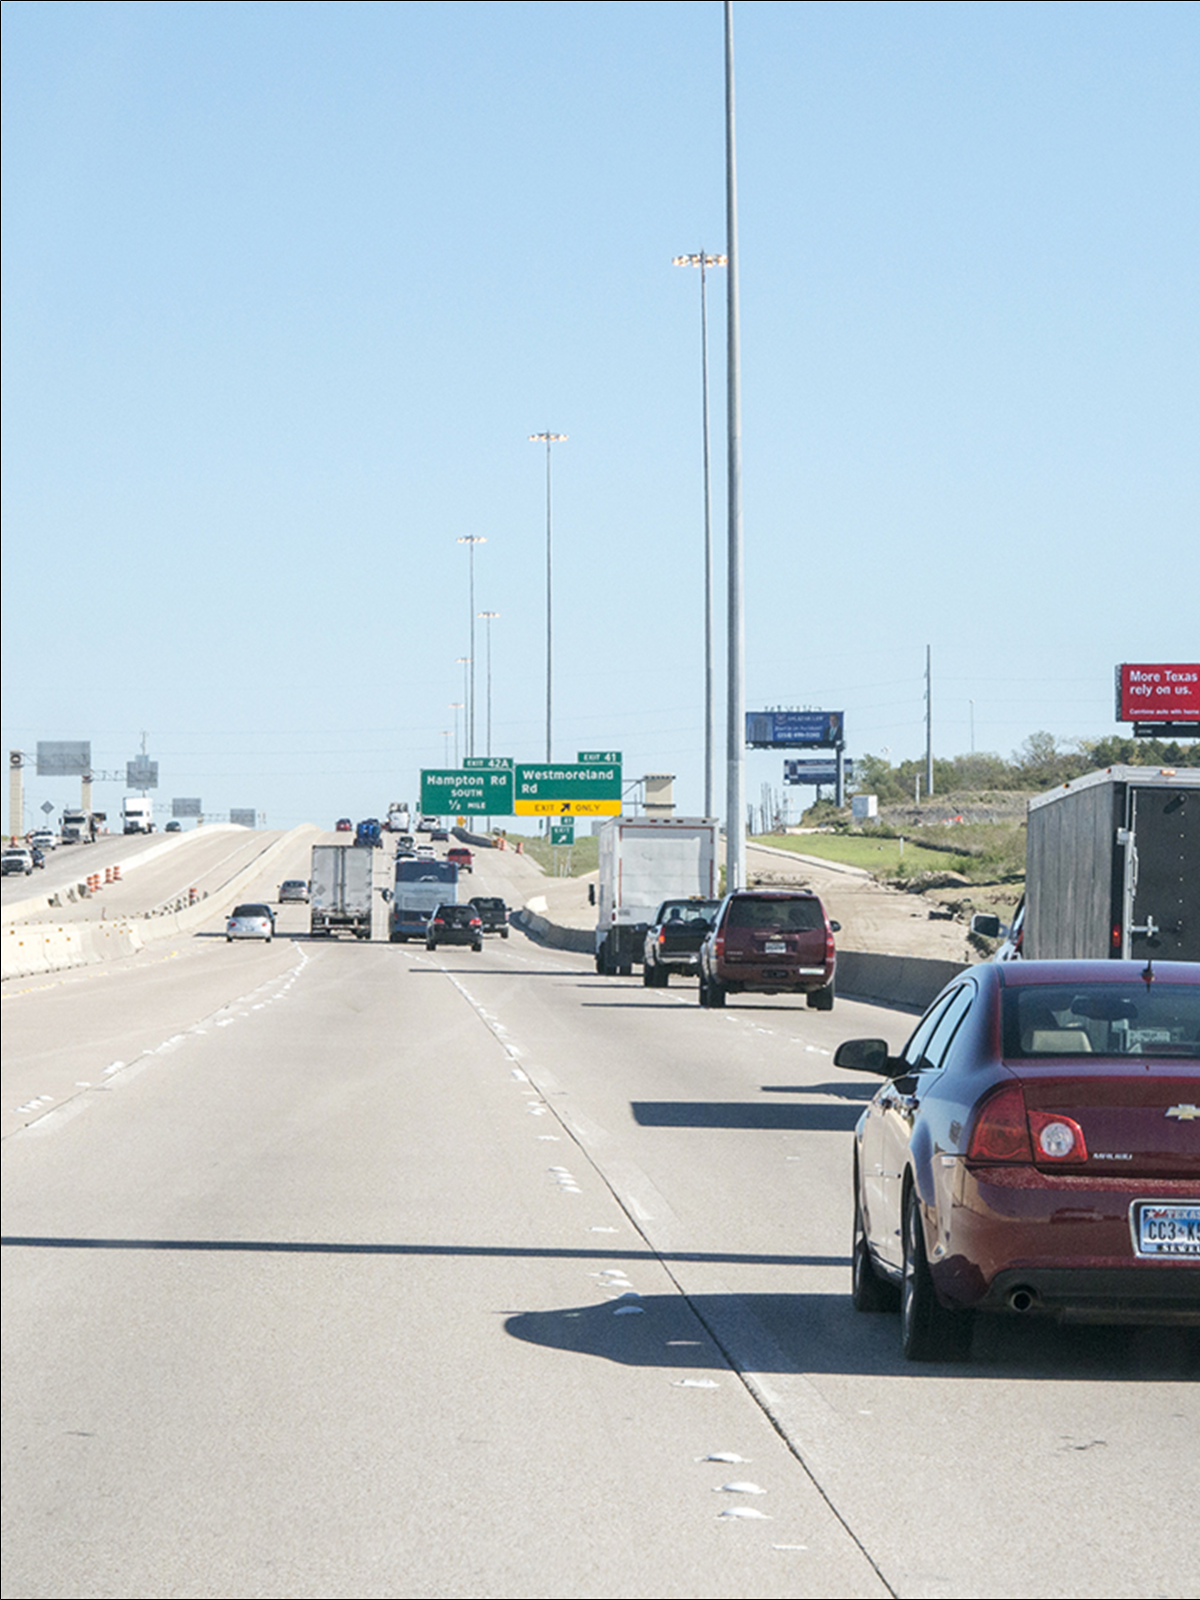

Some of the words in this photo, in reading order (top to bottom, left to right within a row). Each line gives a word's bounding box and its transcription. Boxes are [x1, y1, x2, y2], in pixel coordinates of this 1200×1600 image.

[1130, 670, 1161, 682] More
[1164, 670, 1198, 682] Texas
[1130, 684, 1153, 697] rely
[1156, 685, 1171, 695] on
[1174, 685, 1193, 695] us.
[604, 753, 616, 762] 41
[488, 759, 509, 768] 42A
[522, 769, 614, 780] Westmoreland
[427, 775, 484, 787] Hampton
[490, 775, 507, 785] Rd
[451, 789, 483, 797] SOUTH
[521, 783, 538, 794] Rd
[534, 804, 554, 812] EXIT
[575, 804, 600, 812] ONLY
